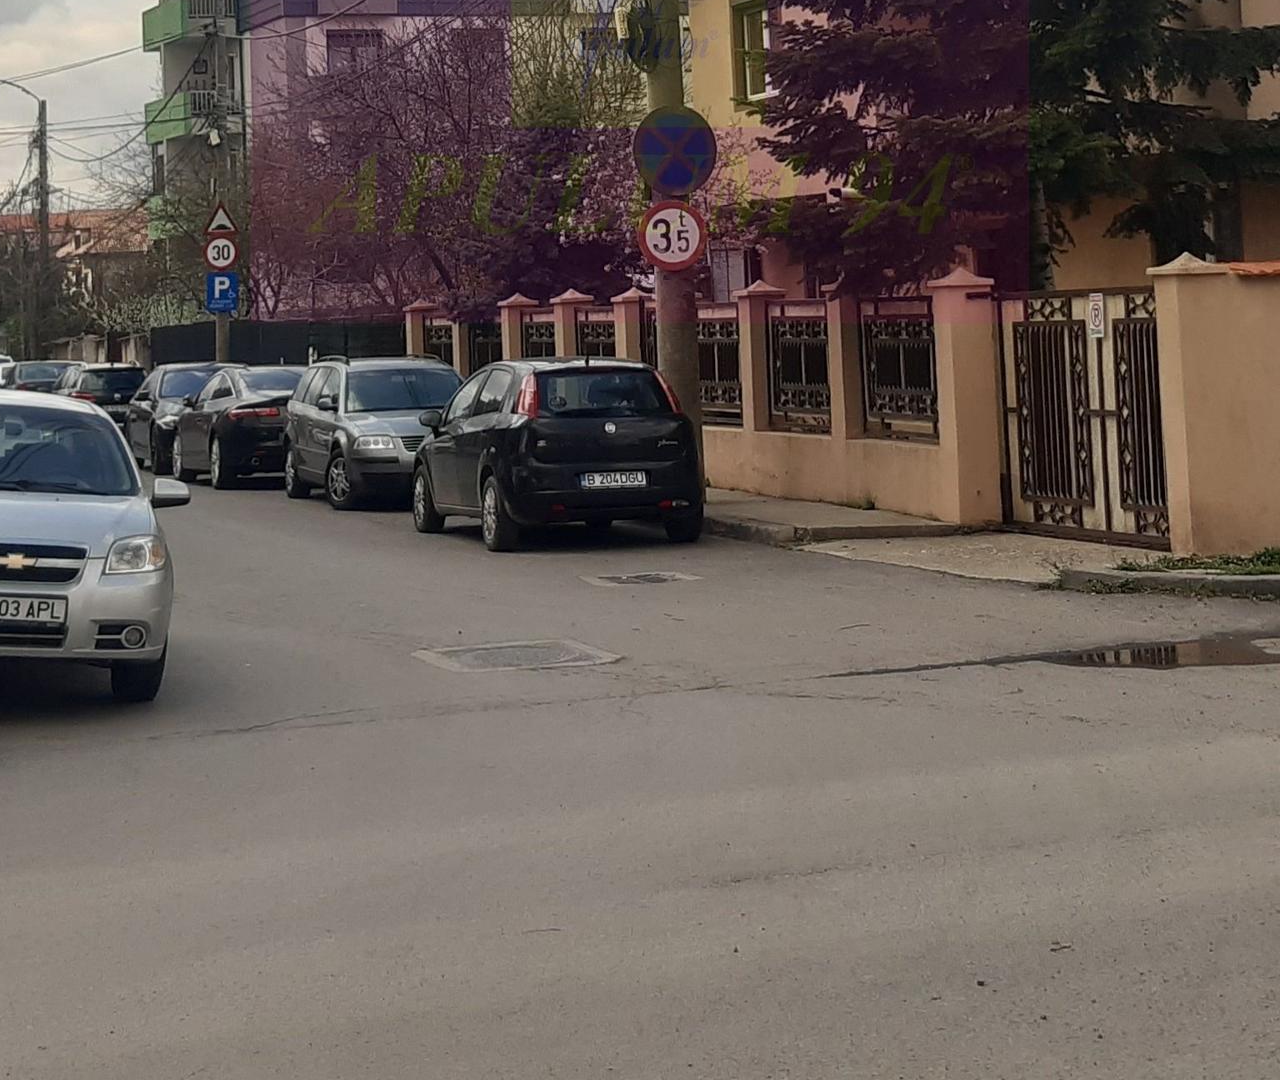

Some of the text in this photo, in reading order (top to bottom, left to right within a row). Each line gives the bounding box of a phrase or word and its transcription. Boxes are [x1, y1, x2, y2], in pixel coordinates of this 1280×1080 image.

[212, 245, 230, 261] 30
[214, 276, 230, 299] P
[587, 474, 596, 485] B
[599, 472, 619, 485] 204
[25, 600, 61, 619] APL
